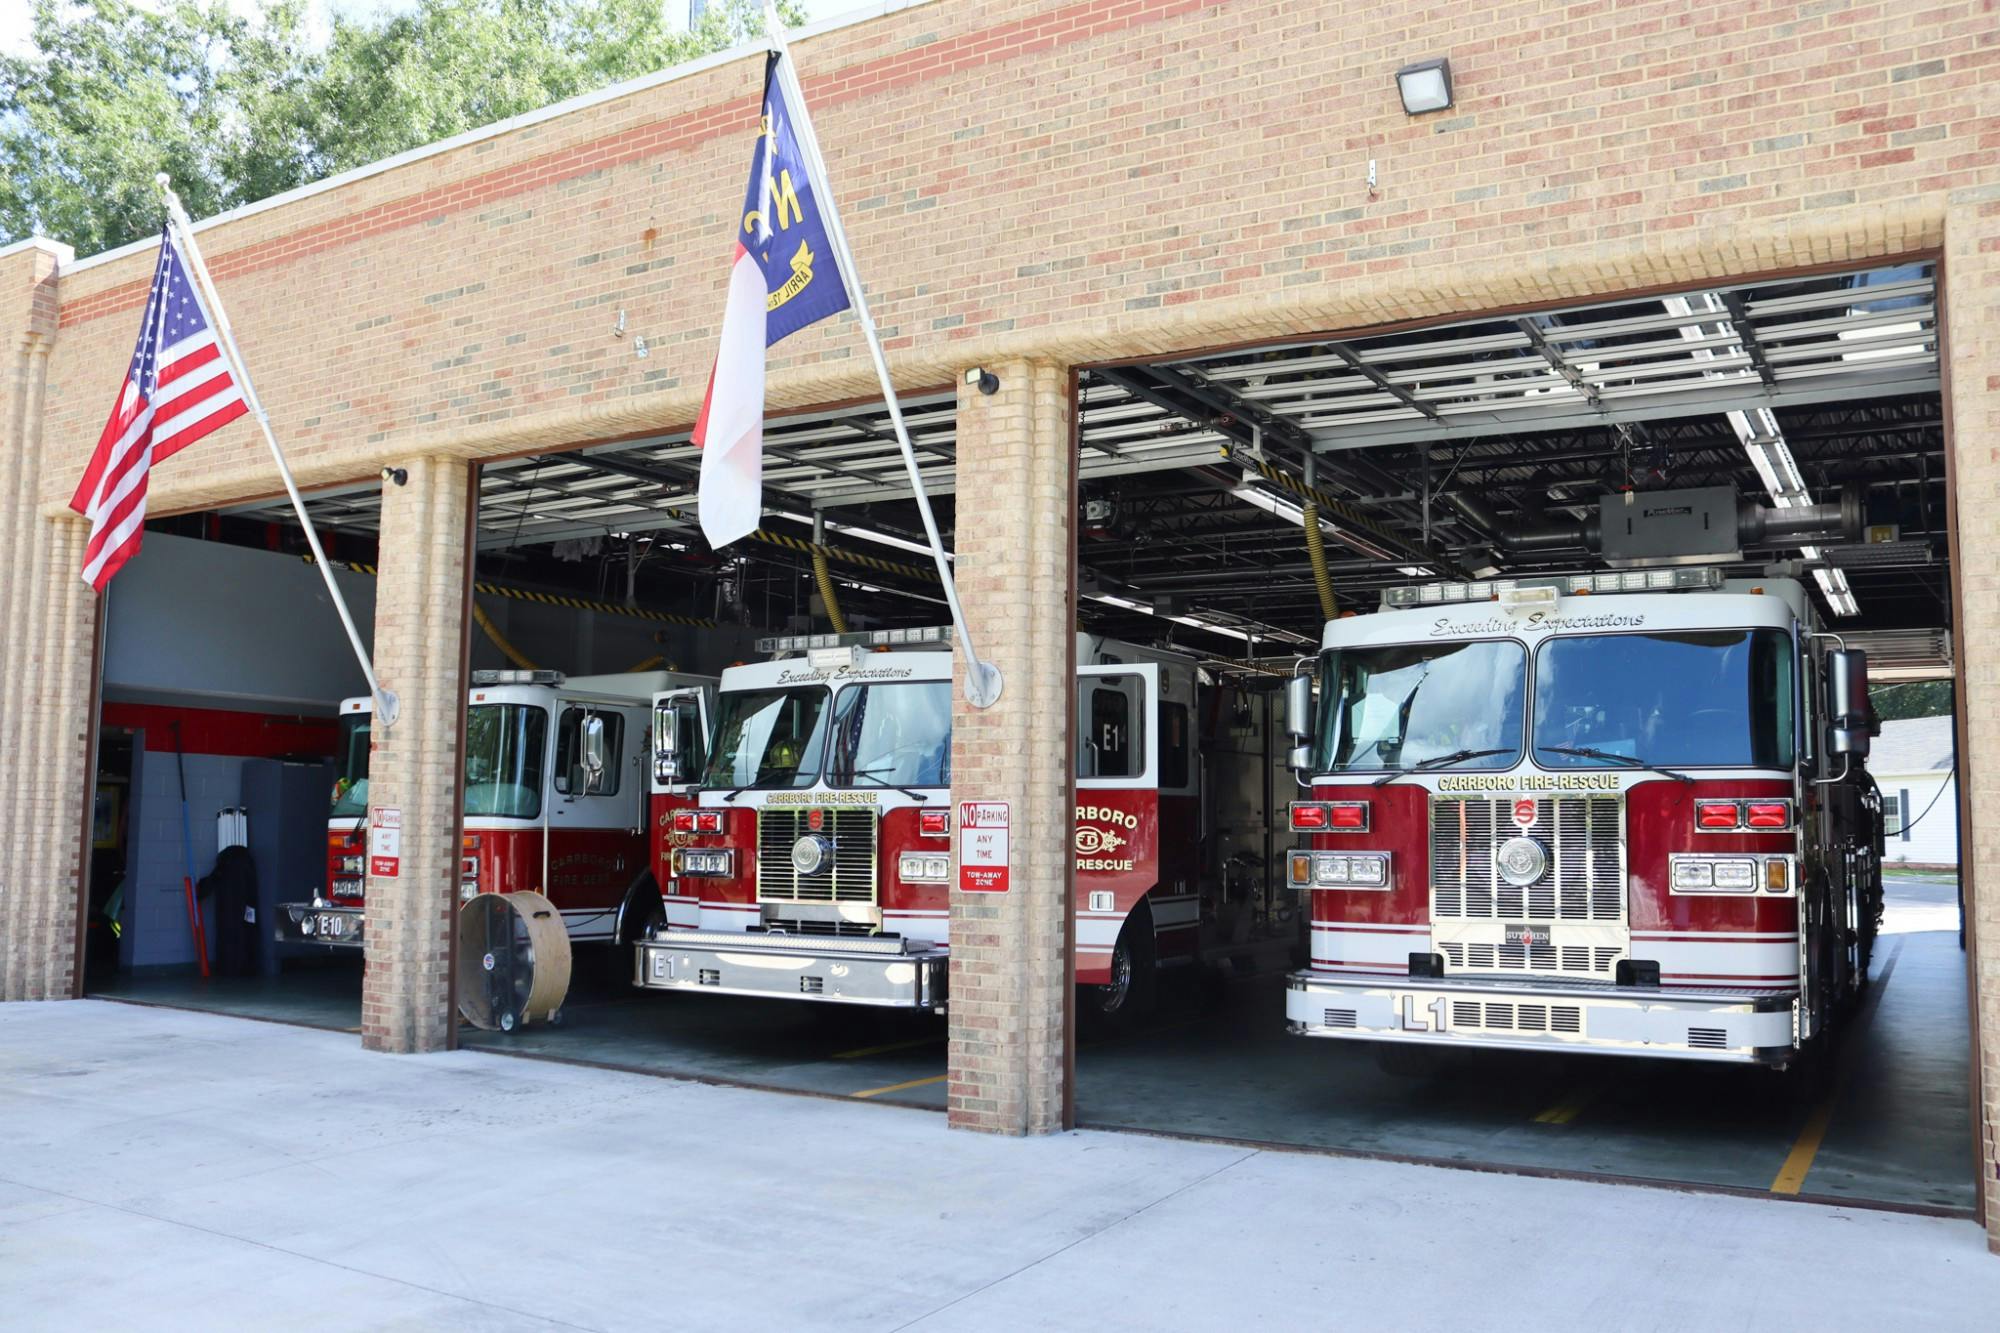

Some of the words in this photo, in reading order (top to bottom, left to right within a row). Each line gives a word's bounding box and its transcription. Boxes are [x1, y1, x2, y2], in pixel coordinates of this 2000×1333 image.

[1430, 616, 1519, 637] Exceeding
[1523, 611, 1645, 635] Expectations
[777, 668, 831, 685] Exceeding
[834, 665, 912, 682] Expectations
[1103, 723, 1119, 752] E1
[1438, 774, 1517, 791] CARRBORO
[1520, 774, 1620, 790] FIRE-RESCUE
[767, 792, 813, 804] CARRBORO
[815, 792, 878, 804] FIRE-RESCUE
[961, 804, 976, 827] NO
[976, 810, 1008, 823] PARKING
[1076, 806, 1138, 829] RBORO
[976, 835, 993, 844] ANY
[976, 849, 993, 860] TIME
[966, 871, 1003, 879] TOW-AWAY
[1076, 859, 1133, 871] RESCUE
[975, 879, 994, 887] ZONE
[320, 916, 342, 936] E10
[654, 954, 675, 979] E1
[1402, 995, 1446, 1032] L1
